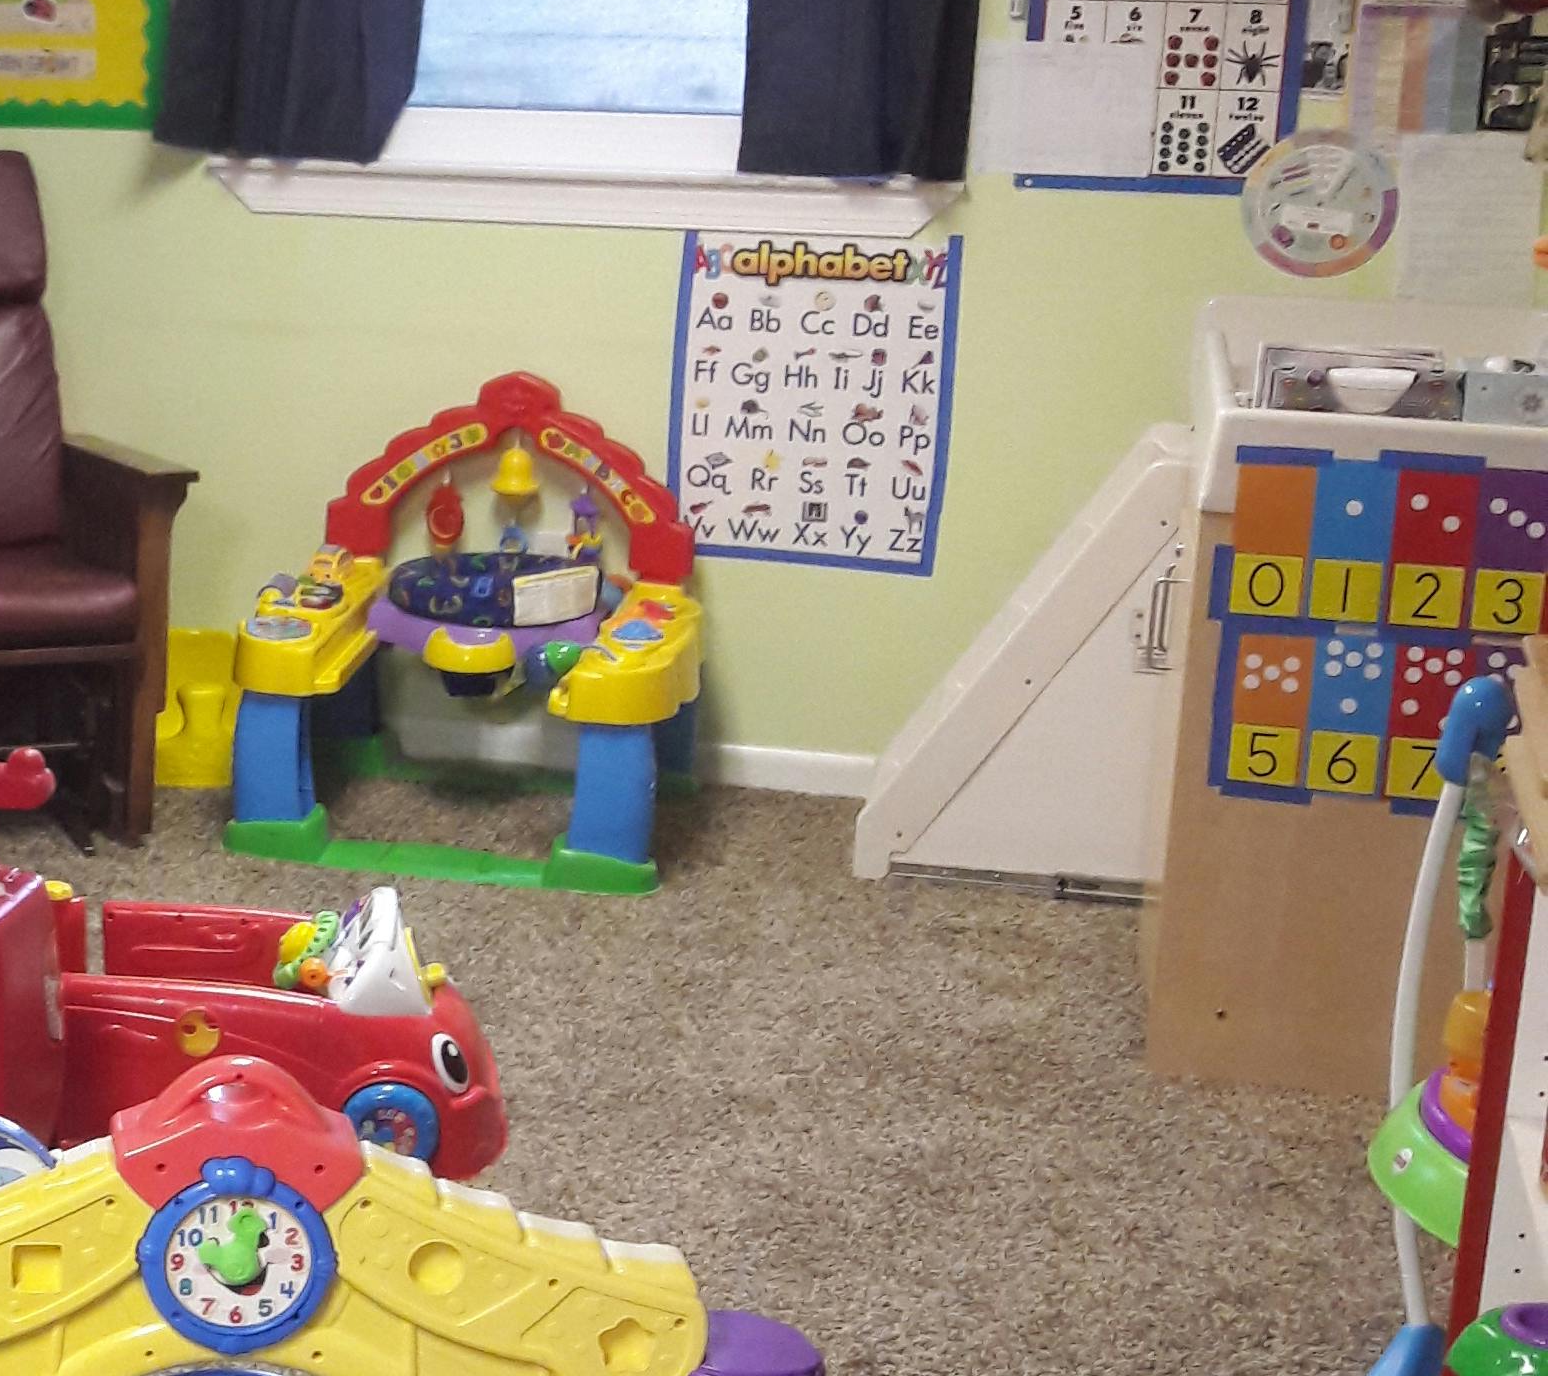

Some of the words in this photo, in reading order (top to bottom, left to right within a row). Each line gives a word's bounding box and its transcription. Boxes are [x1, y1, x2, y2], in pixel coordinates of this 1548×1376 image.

[1070, 6, 1081, 20] 5
[1130, 7, 1142, 21] 6
[1189, 9, 1202, 23] 7
[1251, 10, 1262, 23] 8
[1180, 96, 1196, 109] 11
[1238, 97, 1259, 111] 12
[732, 240, 910, 286] alphabet
[696, 309, 732, 331] Aa
[750, 310, 781, 333] Bb
[801, 311, 836, 335] Cc
[853, 313, 889, 338] Dd
[909, 317, 939, 340] Ee
[694, 361, 716, 383] Ff
[731, 363, 771, 393] Gg
[784, 366, 818, 389] Hh
[834, 368, 849, 390] Ii
[862, 369, 884, 398] Jj
[902, 370, 935, 395] Kk
[692, 413, 708, 436] Ll
[725, 416, 773, 440] Mm
[789, 419, 826, 443] Nn
[843, 422, 885, 447] Oo
[900, 426, 931, 455] Pp
[687, 465, 731, 494] Qq
[751, 468, 779, 491] Rr
[799, 471, 824, 494] Ss
[845, 473, 867, 497] Tt
[893, 477, 926, 501] Uu
[684, 515, 715, 538] Vv
[728, 518, 782, 544] Ww
[792, 523, 828, 546] Xx
[840, 525, 873, 555] Yy
[888, 530, 922, 553] Zz
[1249, 561, 1284, 608] 0
[1342, 567, 1352, 613] 1
[1412, 573, 1441, 620] 2
[1491, 578, 1524, 625] 3
[1247, 732, 1279, 777] 5
[1326, 740, 1357, 785] 6
[1411, 746, 1439, 791] 7
[199, 1206, 218, 1225] 11
[269, 1211, 278, 1229] 1
[178, 1229, 202, 1246] 10
[284, 1228, 298, 1245] 2
[170, 1254, 184, 1272] 9
[291, 1254, 304, 1272] 3
[179, 1278, 193, 1296] 8
[280, 1281, 295, 1298] 4
[201, 1298, 215, 1315] 7
[229, 1306, 243, 1324] 6
[258, 1299, 273, 1317] 5
